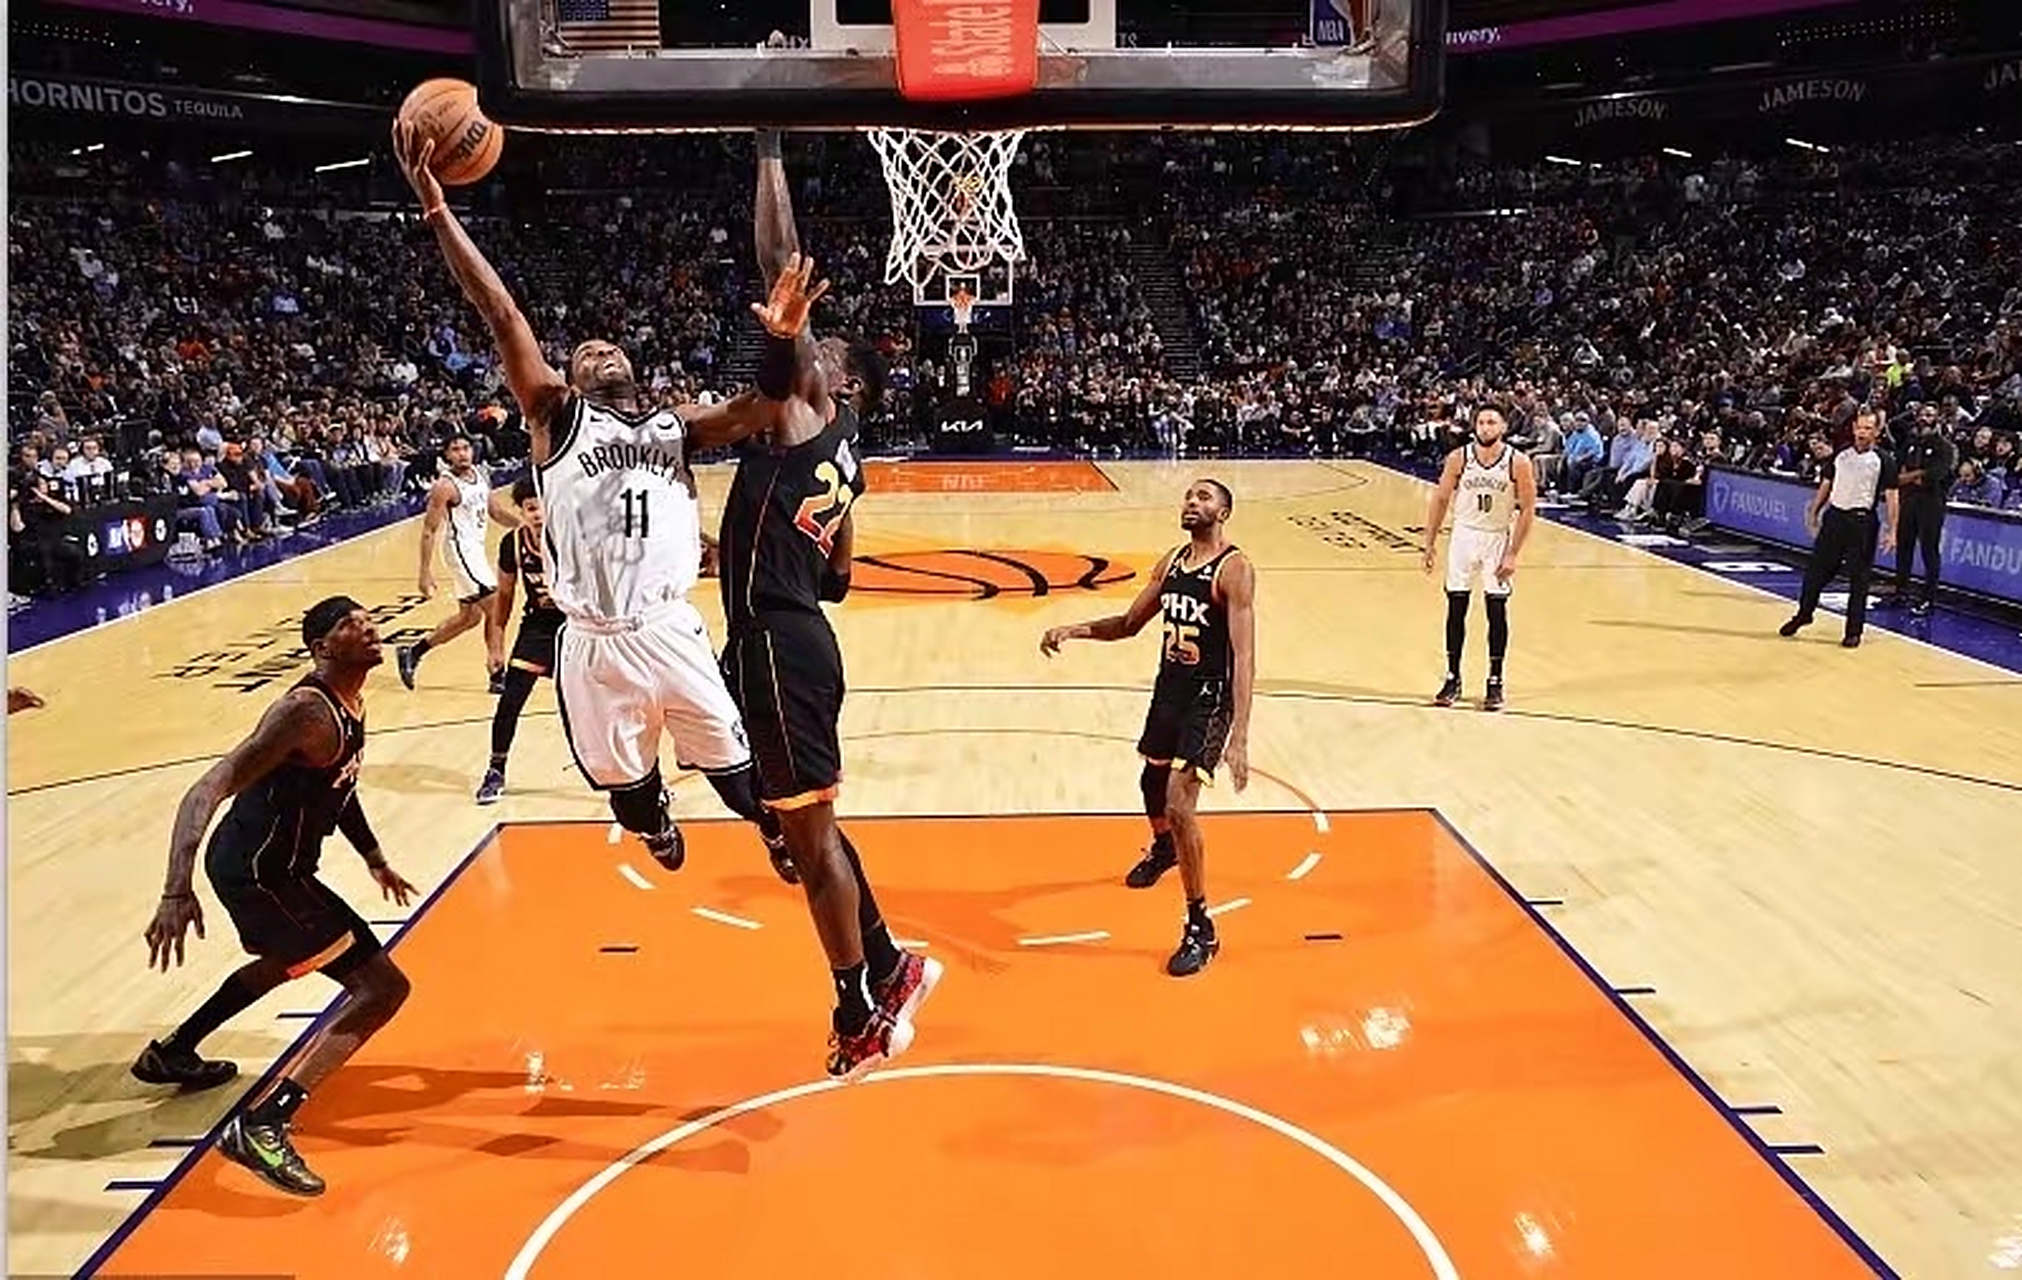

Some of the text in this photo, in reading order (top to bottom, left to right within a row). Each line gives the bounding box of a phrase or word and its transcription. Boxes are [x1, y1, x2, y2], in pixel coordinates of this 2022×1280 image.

[927, 5, 1011, 57] State
[1316, 19, 1346, 41] NBA
[1983, 60, 2022, 91] JA
[7, 77, 244, 119] HORNITOS TEQUILA
[1573, 98, 1669, 128] JAMESON
[1757, 79, 1867, 113] JAMESON
[619, 487, 649, 539] 11
[1476, 493, 1493, 514] 10
[1730, 490, 1790, 523] FANDUEL
[1160, 592, 1210, 628] PHX
[1163, 620, 1200, 665] 25
